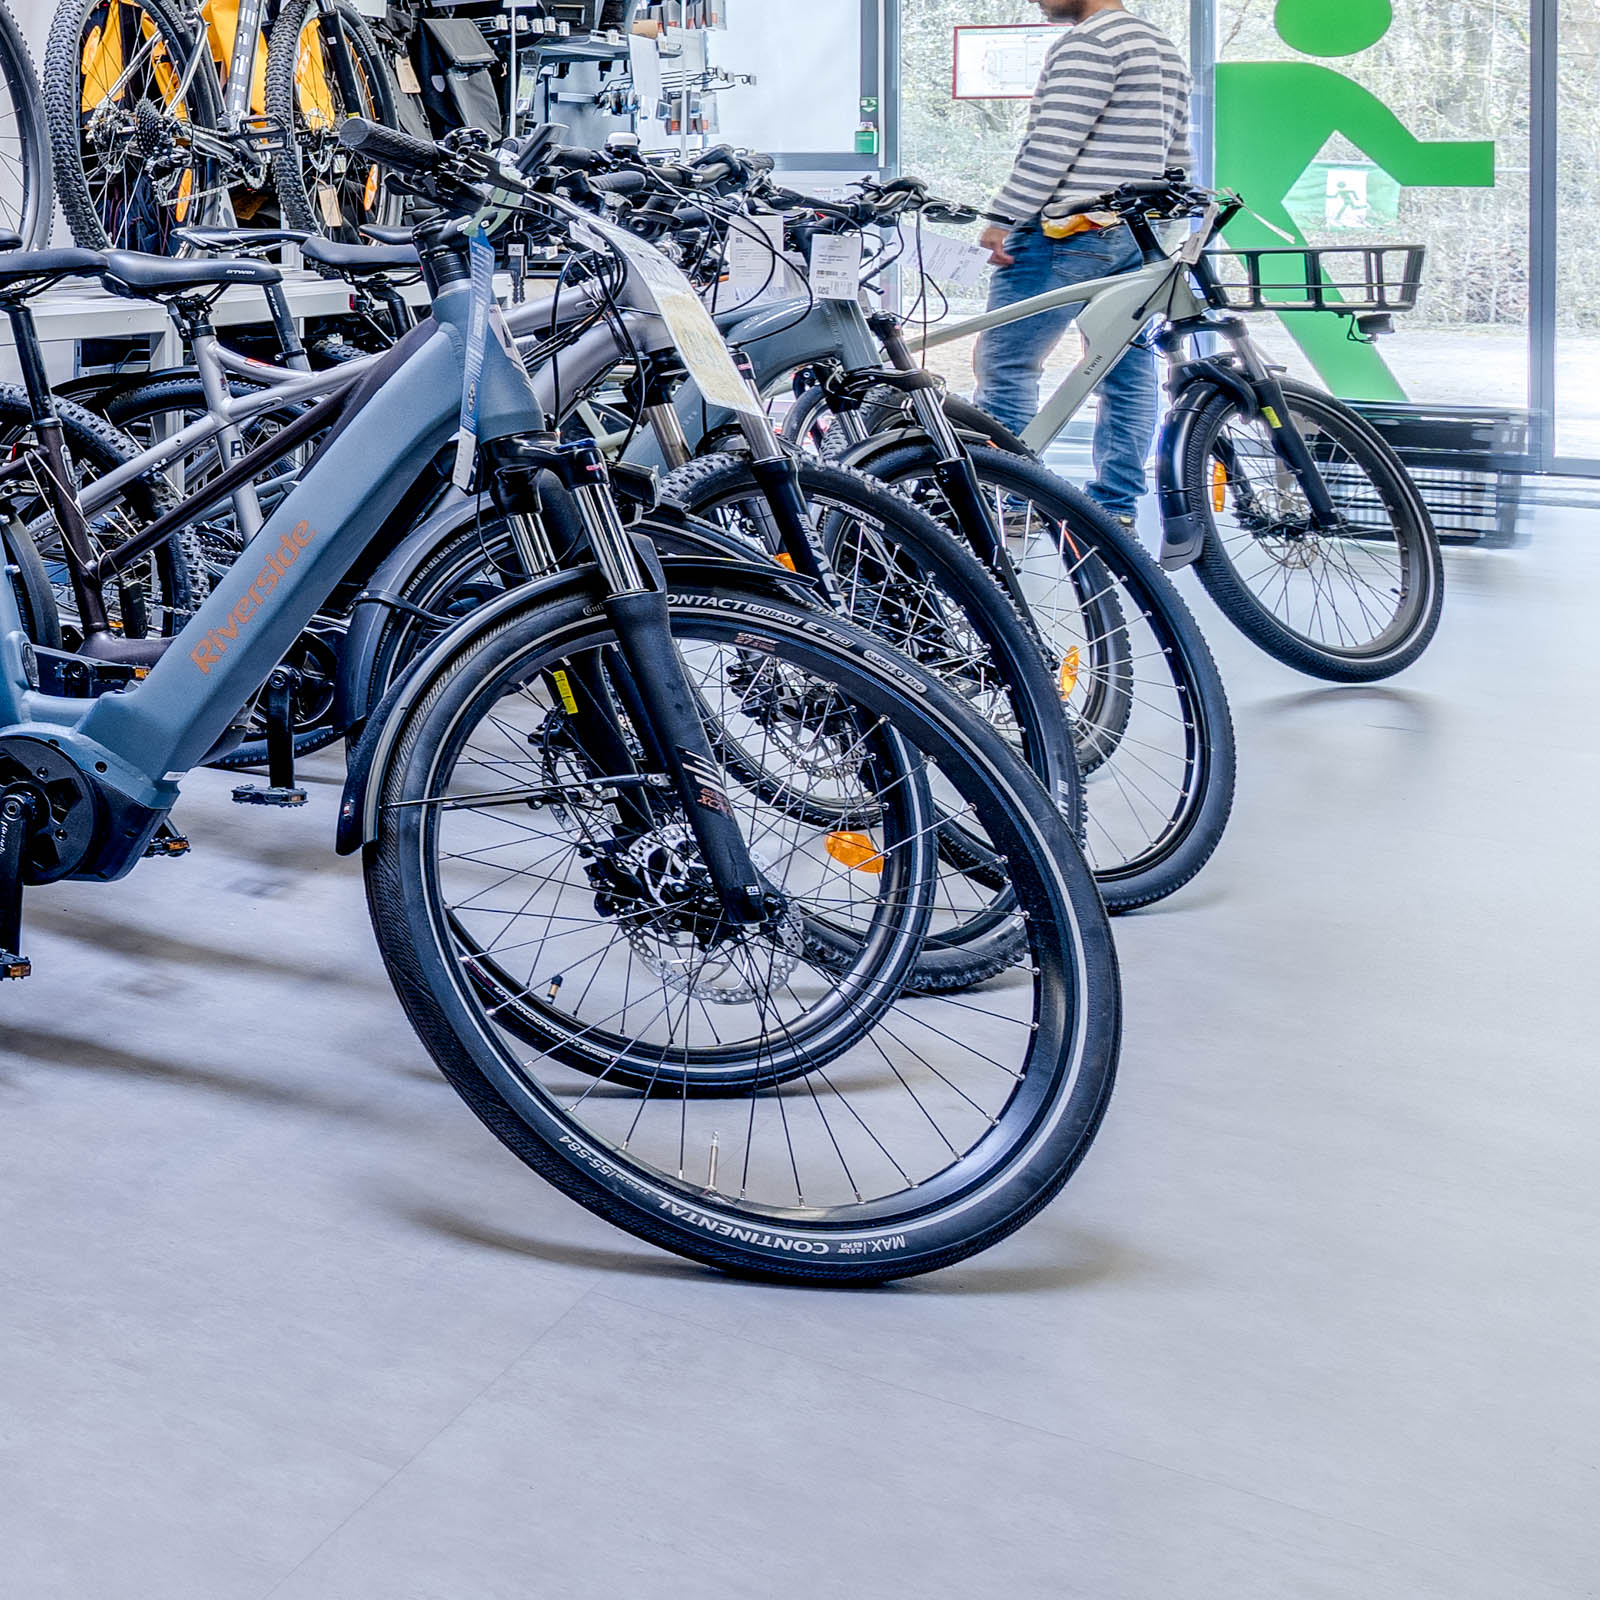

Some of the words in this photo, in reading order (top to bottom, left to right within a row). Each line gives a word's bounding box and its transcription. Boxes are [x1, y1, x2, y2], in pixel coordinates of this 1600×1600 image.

[190, 520, 317, 675] Riverside
[666, 593, 748, 611] ONTACT
[750, 604, 801, 625] URBAN
[658, 1197, 829, 1255] CONTINENTAL
